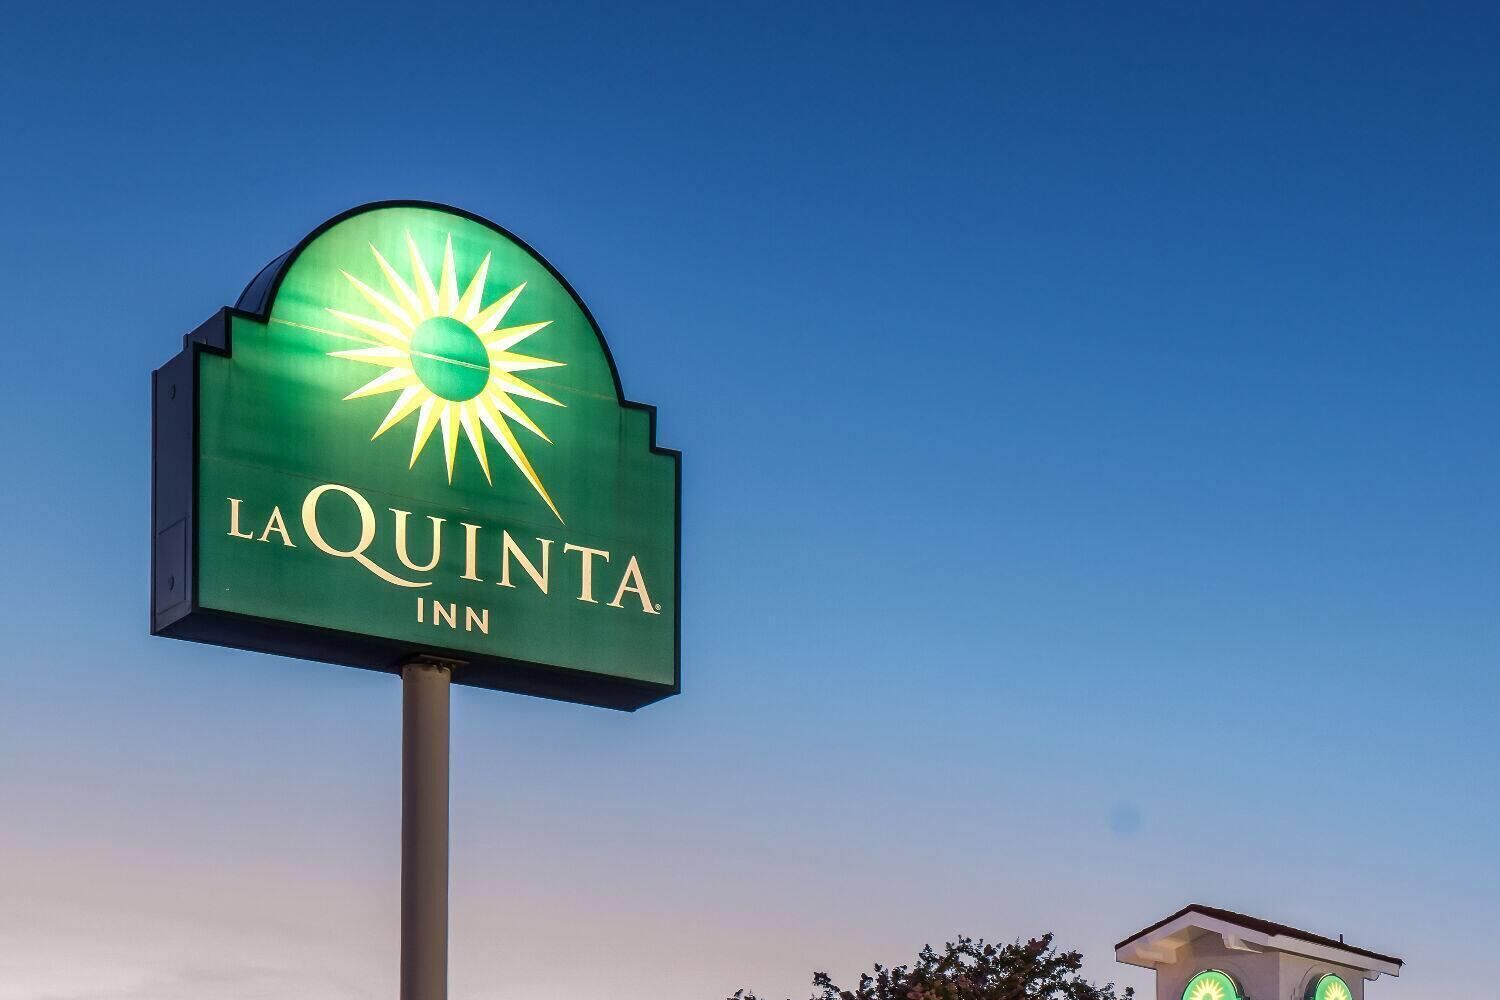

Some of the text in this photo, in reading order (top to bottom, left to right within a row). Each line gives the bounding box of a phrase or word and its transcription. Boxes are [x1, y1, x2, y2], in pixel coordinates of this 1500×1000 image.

[227, 484, 661, 615] LA QUINTA
[417, 597, 489, 635] INN
